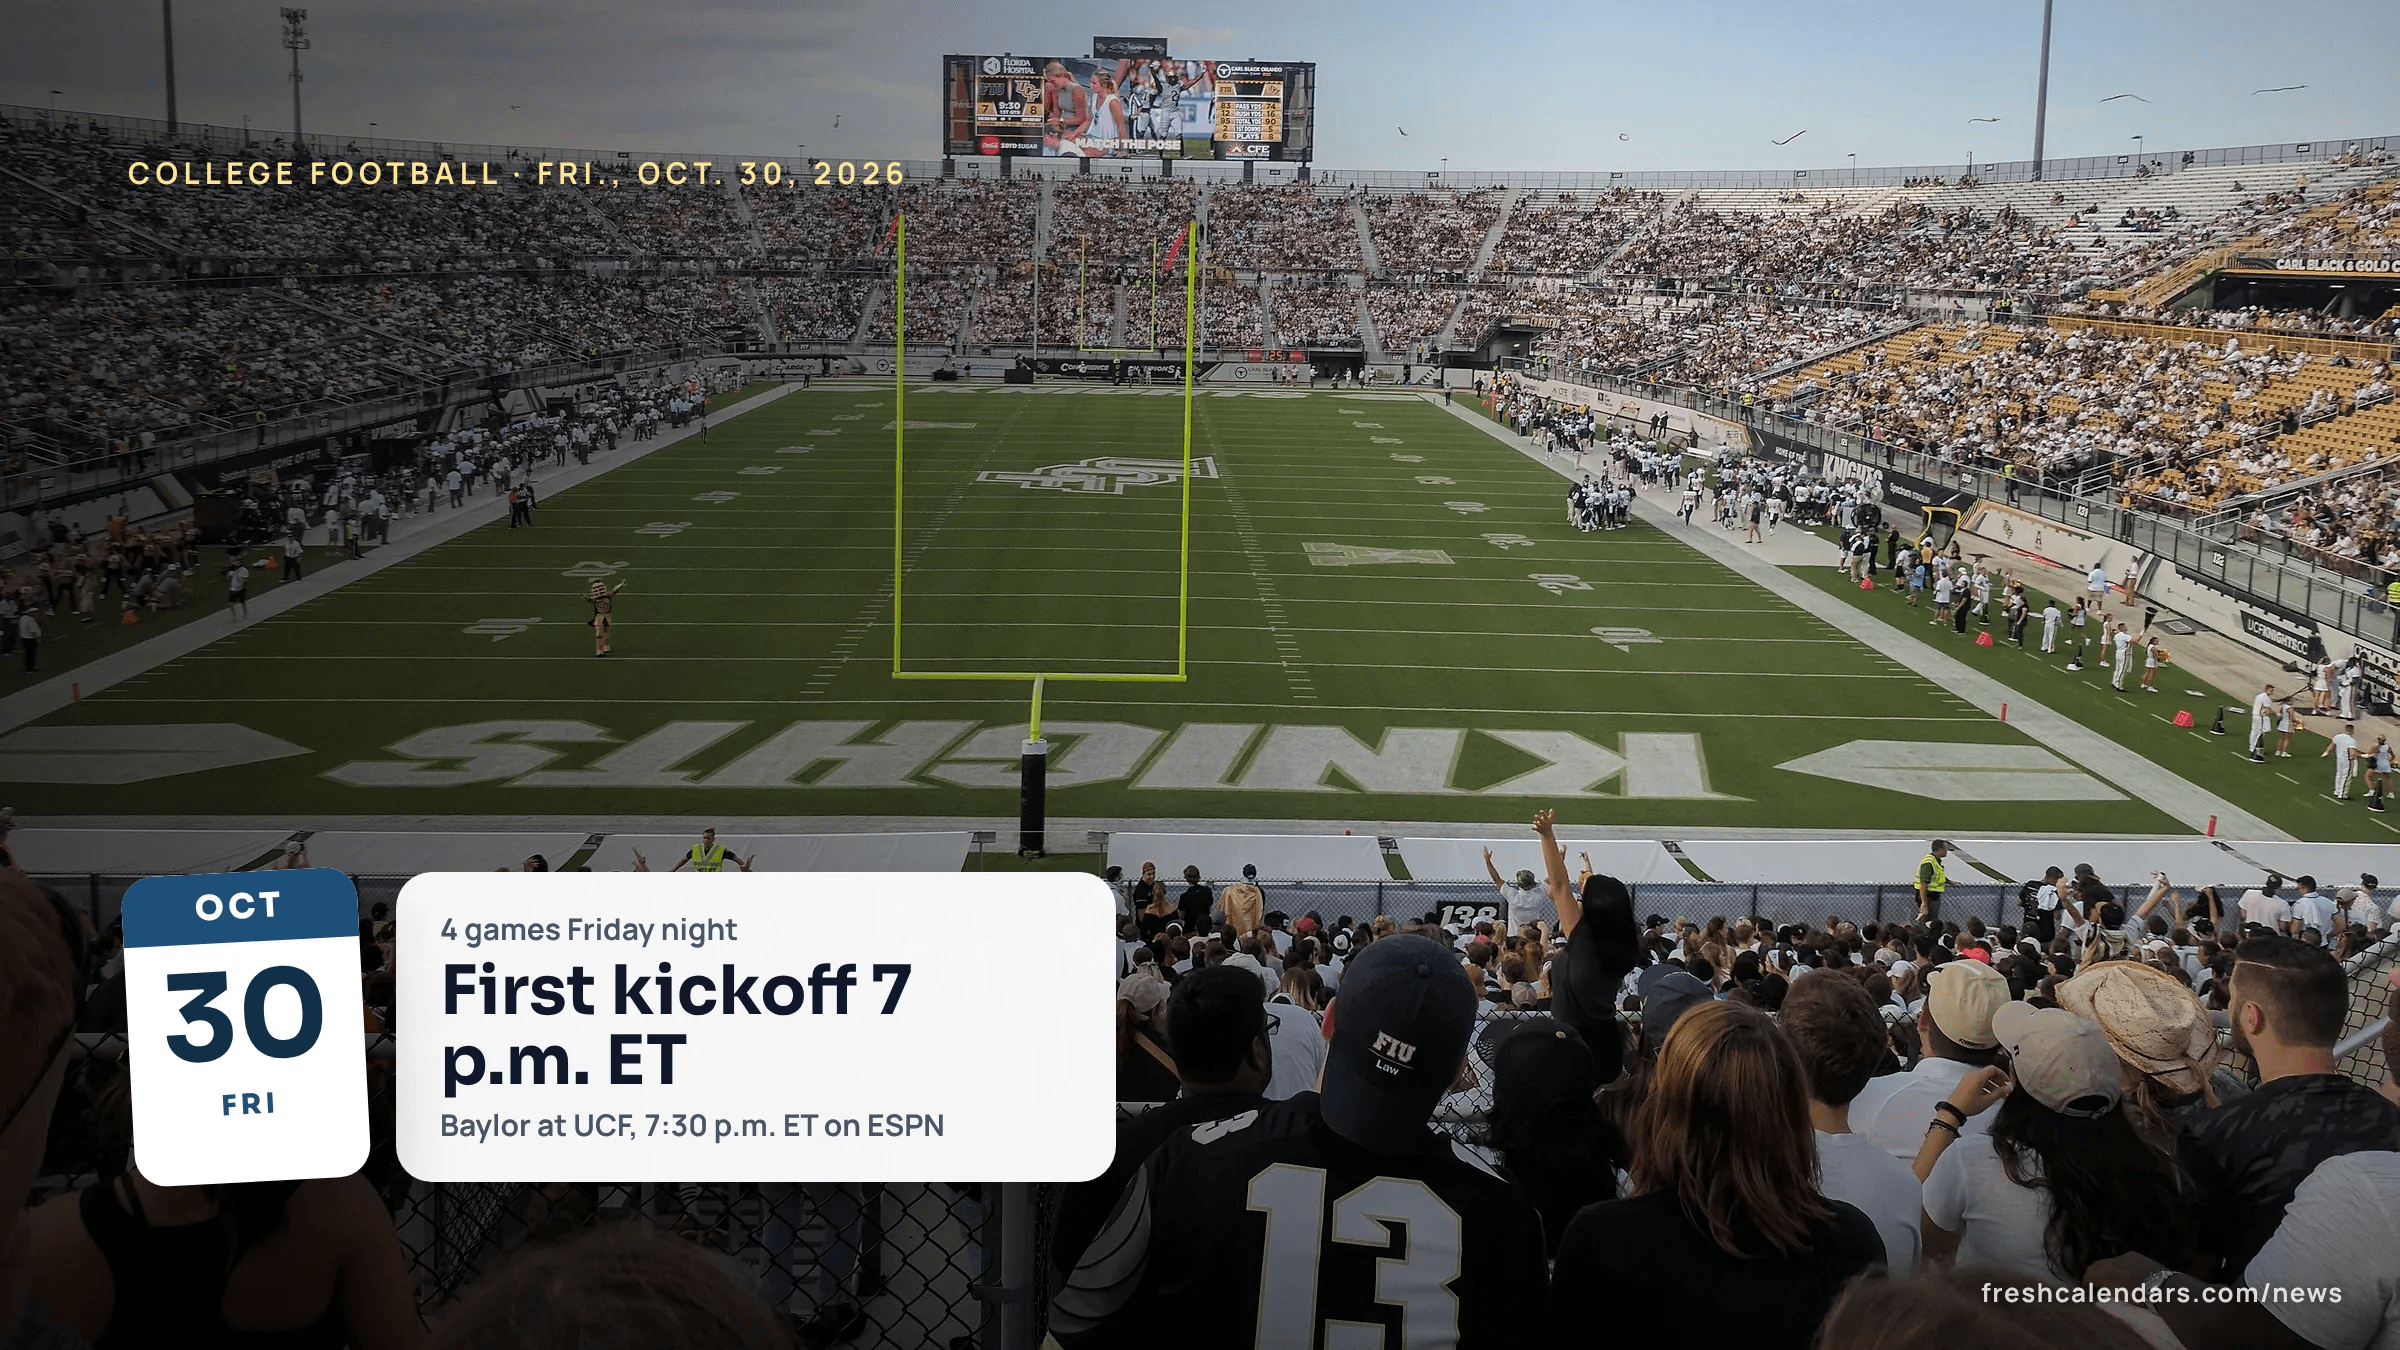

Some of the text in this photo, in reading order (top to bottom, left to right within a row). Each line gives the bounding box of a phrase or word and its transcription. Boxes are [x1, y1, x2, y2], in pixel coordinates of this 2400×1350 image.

[1004, 58, 1031, 66] FLORIDA
[1003, 66, 1036, 74] HOSPITAL
[980, 82, 1005, 95] FIU
[1014, 80, 1042, 102] UCF
[982, 104, 990, 114] 7
[998, 101, 1021, 110] 9:30
[1030, 105, 1037, 115] 8
[1075, 138, 1182, 150] MATCH THE POSE
[1247, 145, 1270, 153] CFE
[2276, 259, 2305, 271] CARL
[2306, 259, 2345, 272] BLACK
[2346, 260, 2354, 272] &
[2355, 260, 2390, 273] GOLD
[1269, 350, 1283, 361] 25
[271, 457, 294, 471] HOME
[306, 448, 321, 460] THE
[317, 720, 1755, 801] KNIGHTS
[1440, 905, 1498, 929] 138
[1372, 1030, 1416, 1063] FIU
[1375, 1059, 1400, 1076] Law
[1246, 1161, 1463, 1350] 13
